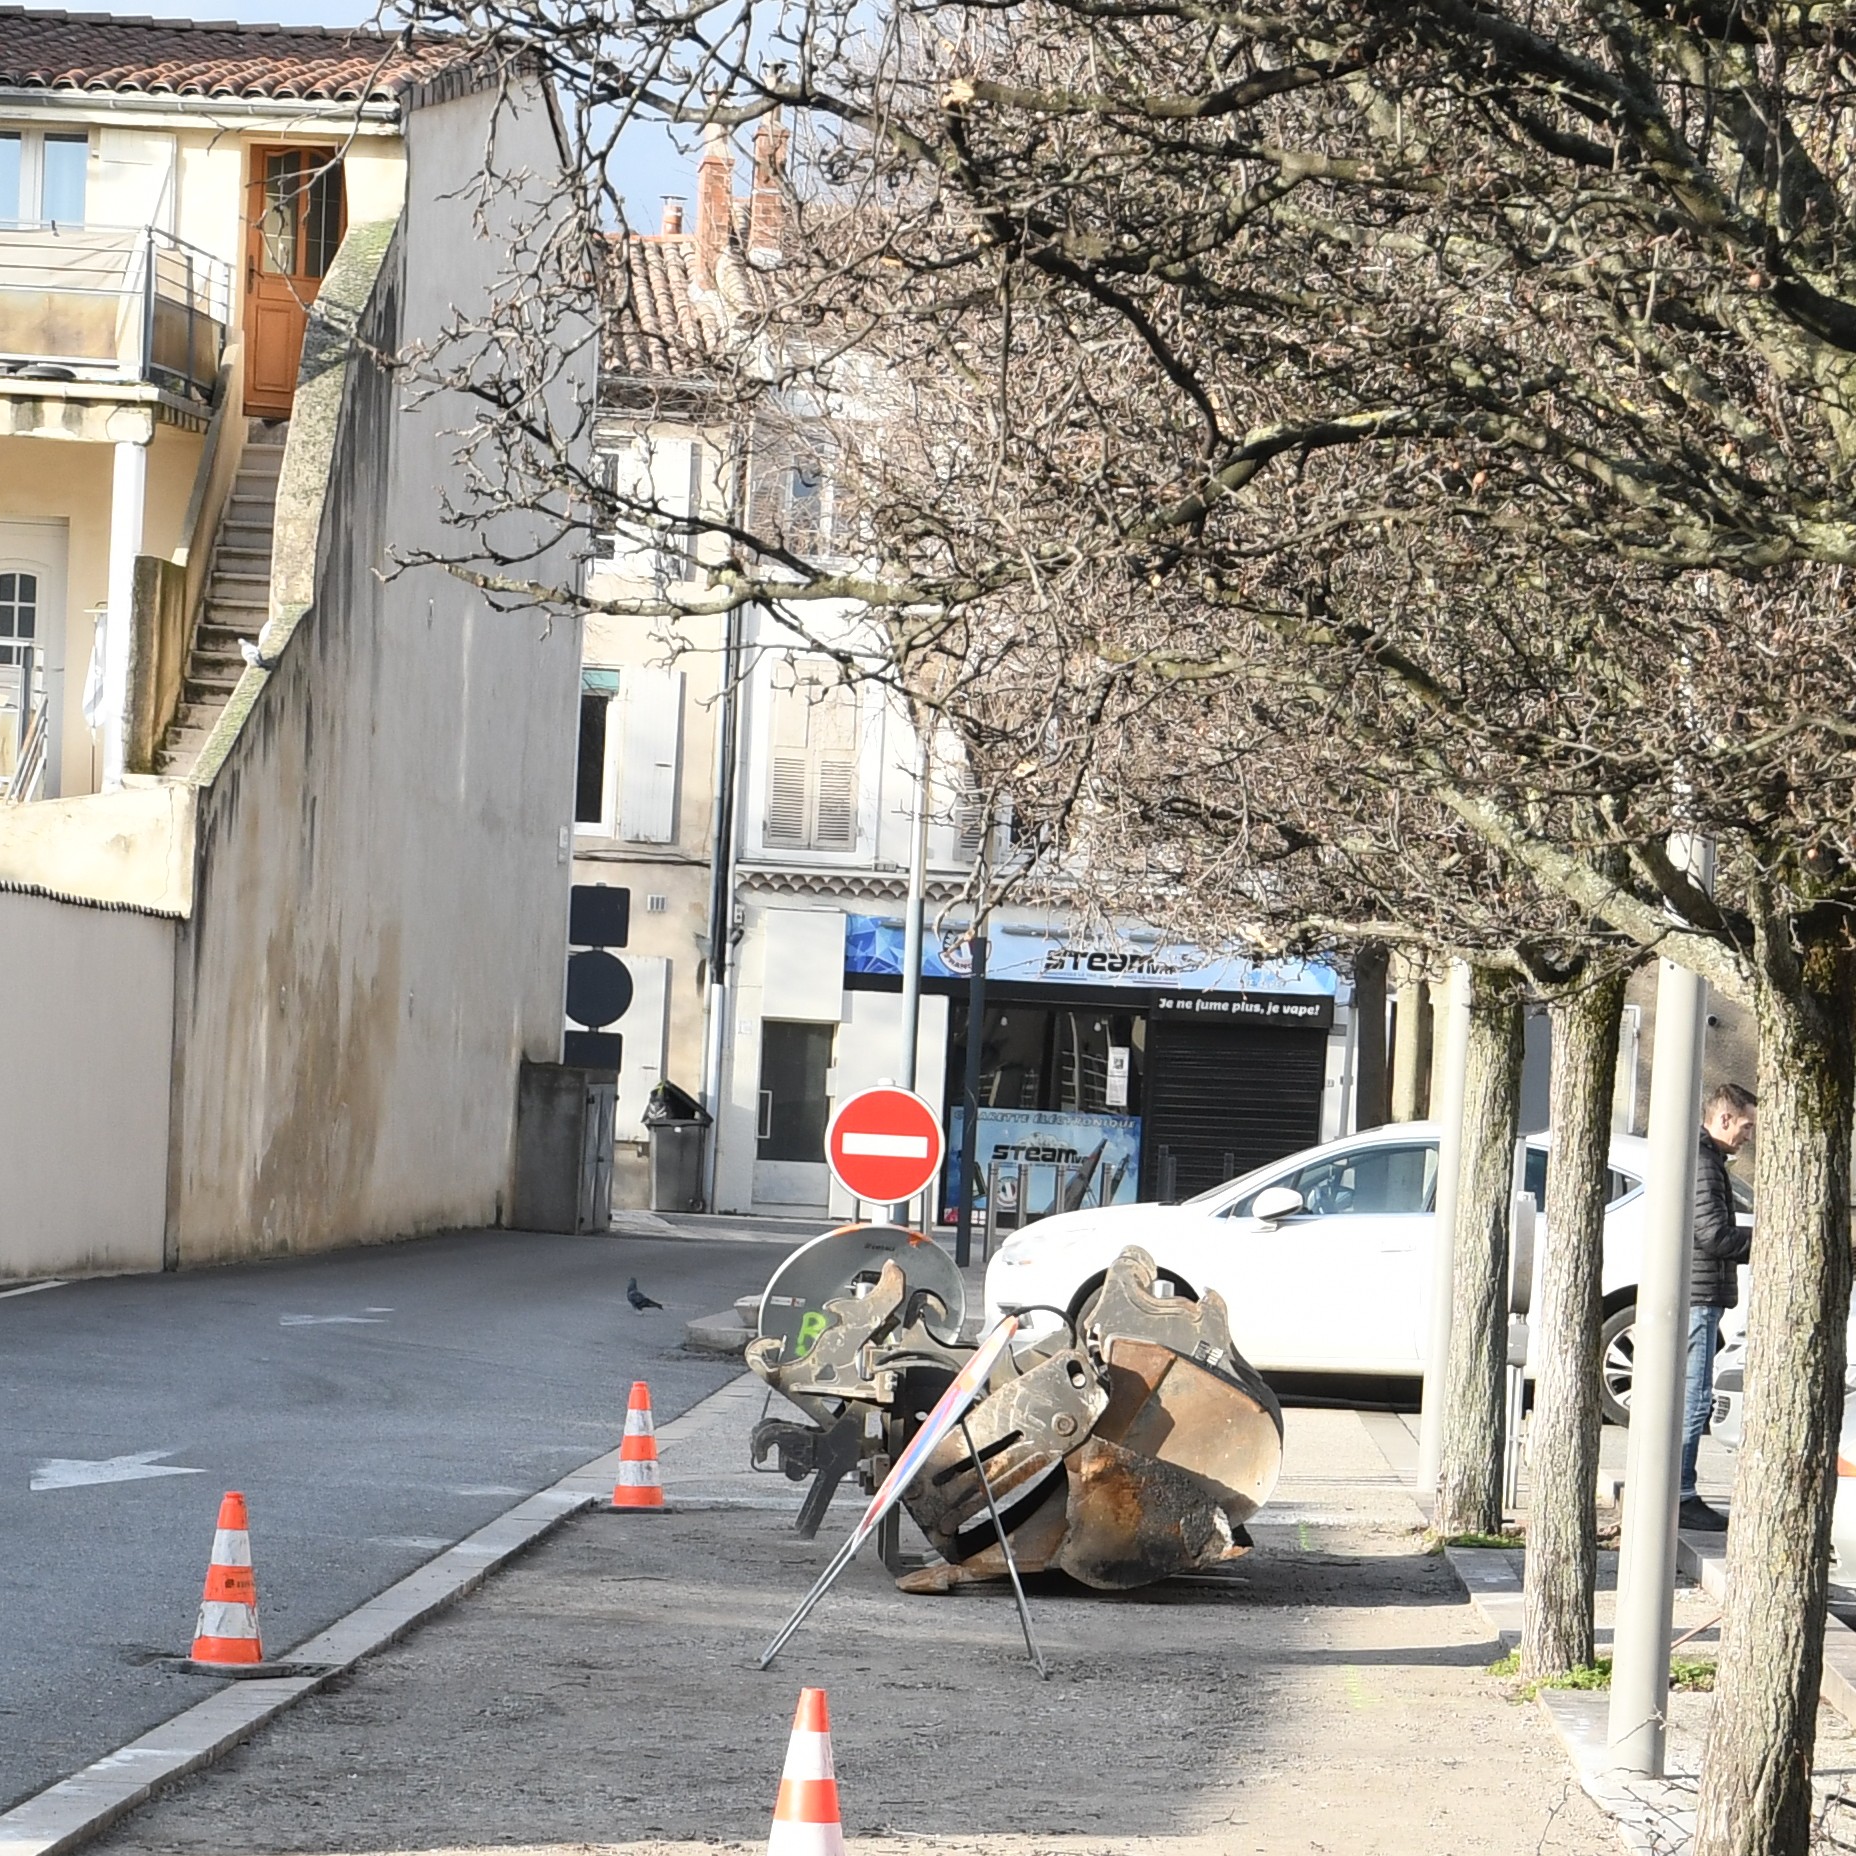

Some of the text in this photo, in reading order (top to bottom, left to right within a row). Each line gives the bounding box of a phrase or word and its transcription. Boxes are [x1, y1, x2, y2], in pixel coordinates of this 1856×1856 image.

[1158, 997, 1320, 1017] Je ne fume plus, je vape!
